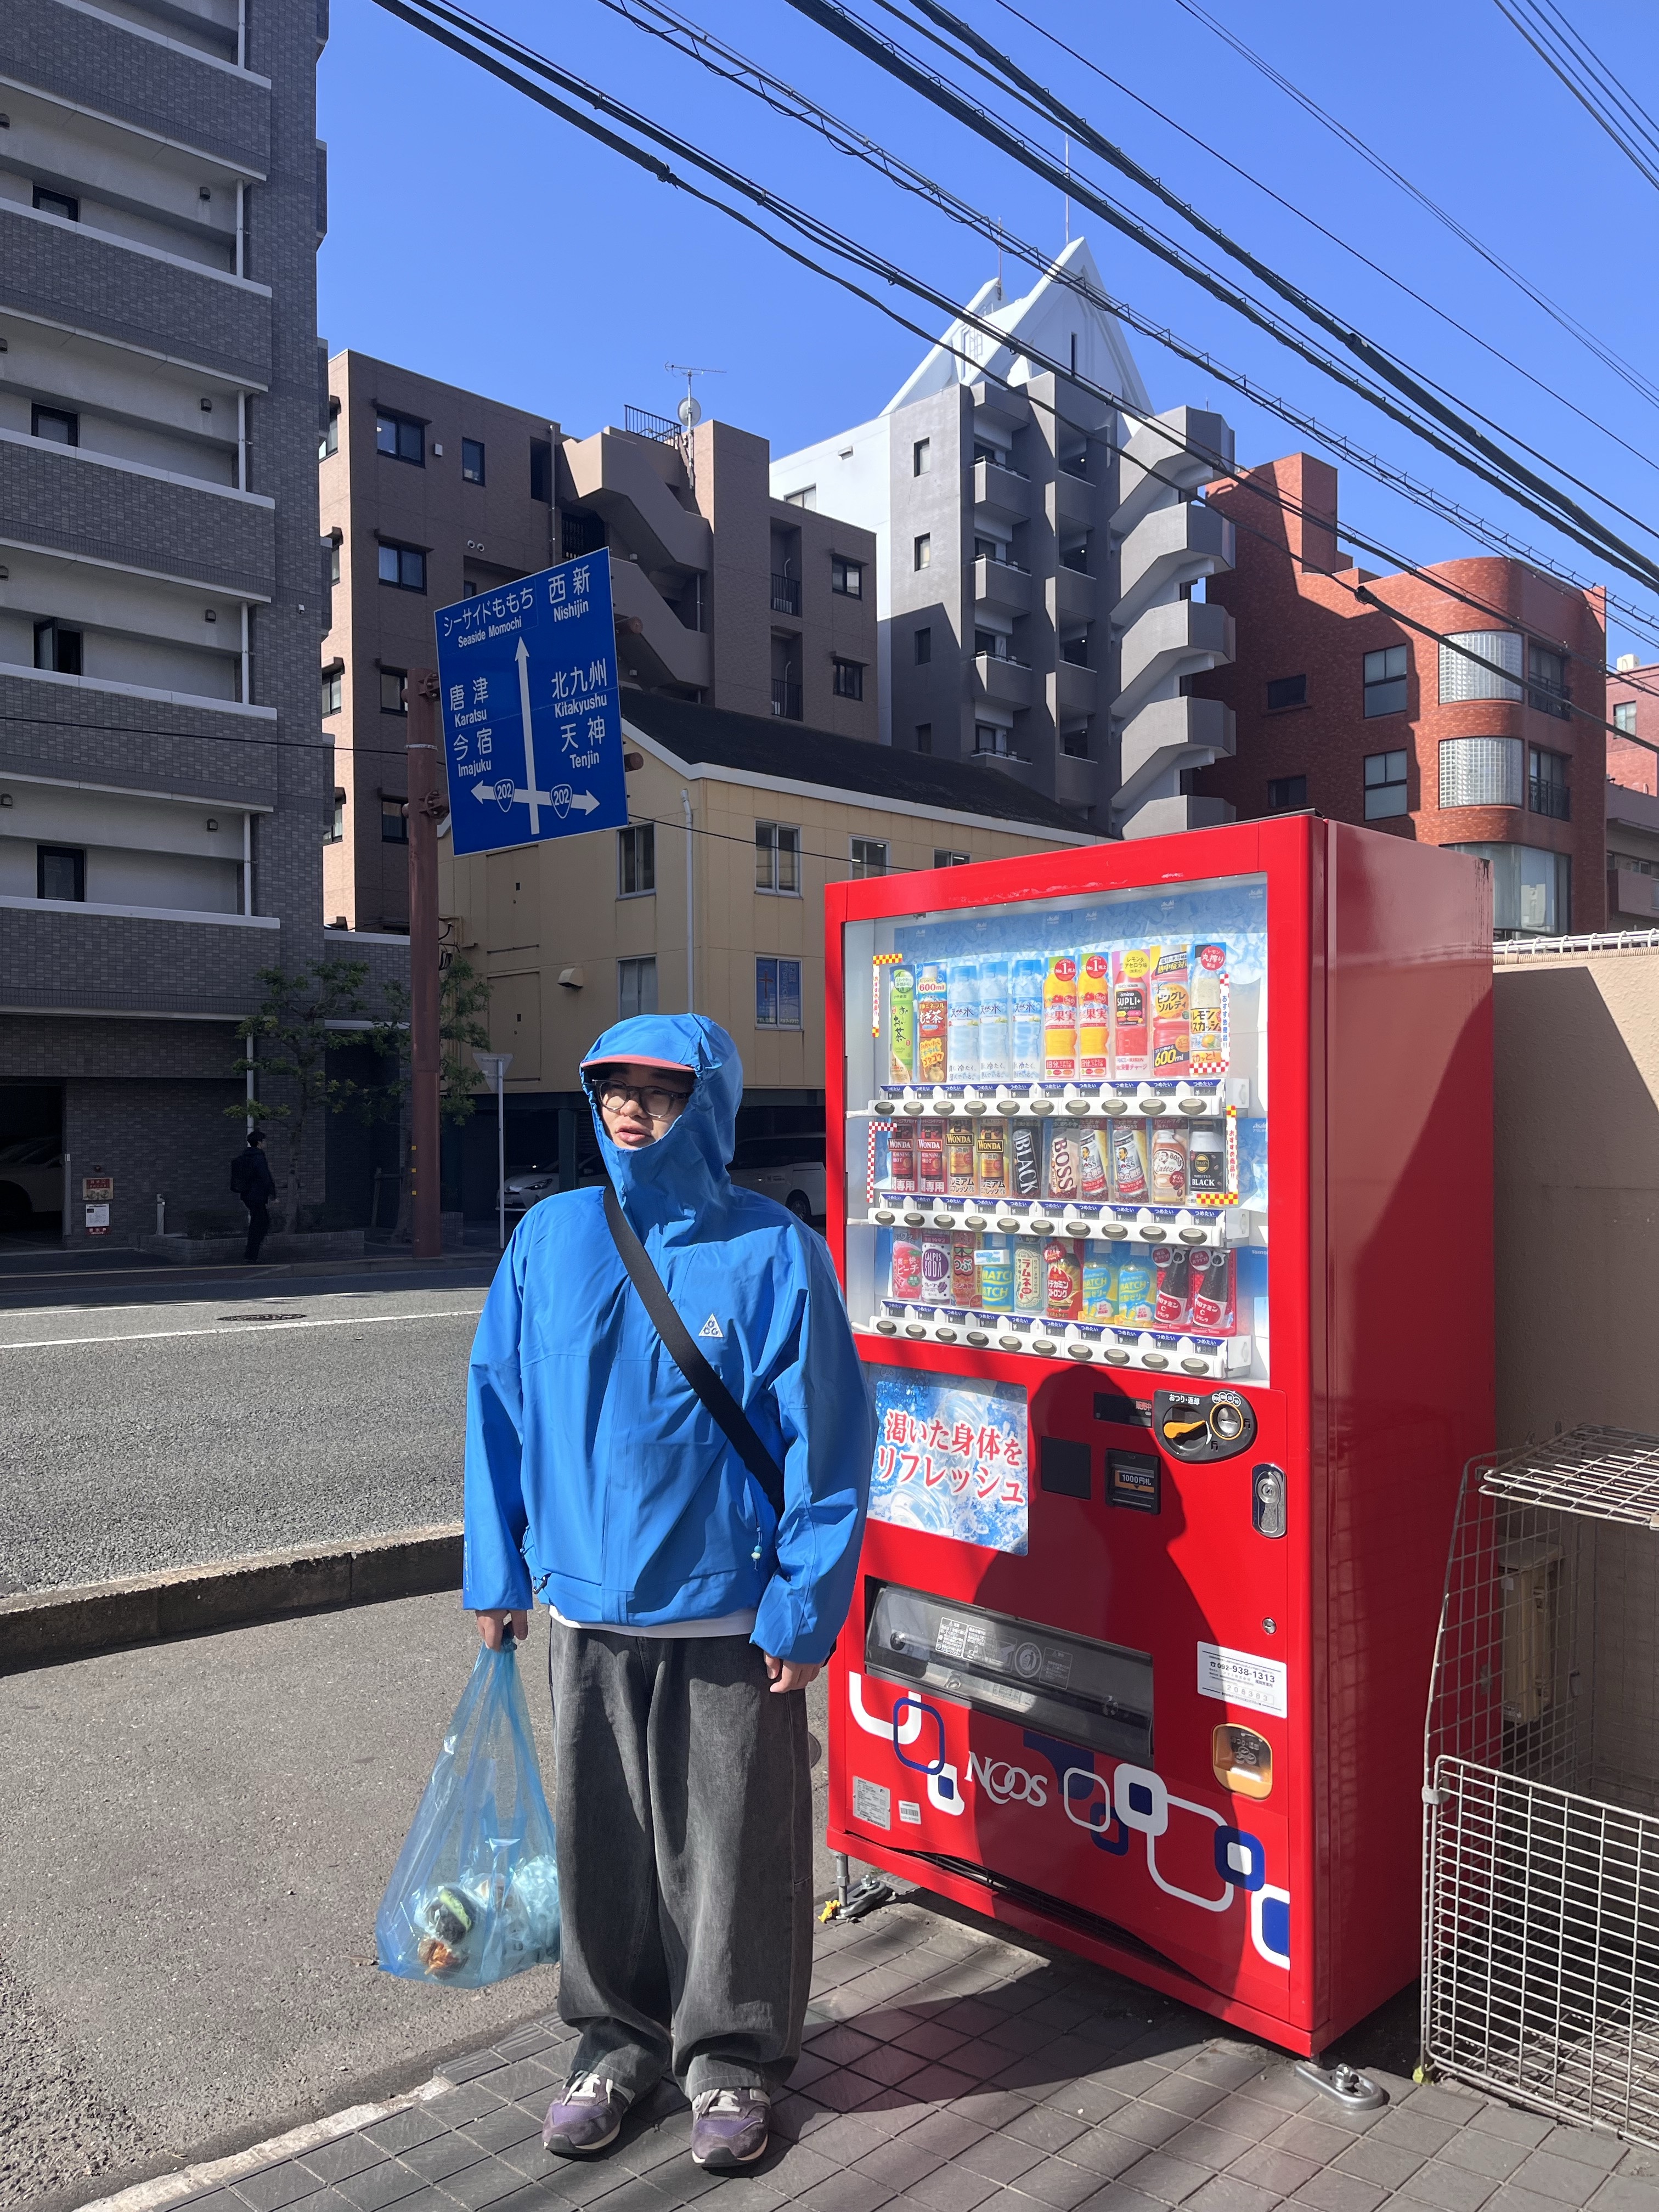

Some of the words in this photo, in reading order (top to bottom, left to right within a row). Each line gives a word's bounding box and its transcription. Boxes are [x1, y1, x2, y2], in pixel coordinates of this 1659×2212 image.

[548, 565, 590, 604] 西新
[444, 587, 533, 637] シーサイドももち
[554, 601, 589, 622] Nishijin
[458, 629, 486, 648] Seaside
[488, 616, 522, 637] Momochi
[551, 658, 607, 699] 北九州
[450, 677, 488, 711] 唐津
[555, 692, 607, 718] Kitakyushu
[454, 710, 487, 728] Karatsu
[560, 715, 605, 752] 天神
[453, 727, 492, 761] 今宿
[458, 758, 492, 777] Imajuku
[569, 751, 600, 769] Tenjin
[497, 783, 512, 799] 202
[554, 789, 569, 806] 202
[1201, 953, 1224, 964] 丸搾り
[919, 983, 944, 991] 600ml
[1117, 997, 1141, 1007] SUPLI+
[1158, 992, 1186, 1003] ピングレ
[951, 1007, 974, 1017] 天然水
[980, 1005, 1001, 1014] 天然水
[1015, 1003, 1035, 1013] 天然水
[1159, 1001, 1187, 1012] ソルティ
[920, 1009, 944, 1024] むぎ茶
[1154, 1049, 1183, 1066] 600ml
[889, 1139, 911, 1148] WONDA
[918, 1139, 940, 1149] WONDA
[946, 1134, 971, 1143] WONDA
[978, 1140, 1001, 1149] WONDA
[1015, 1137, 1039, 1194] BLACK
[1054, 1137, 1074, 1190] BOSS
[1170, 1153, 1182, 1166] BOSS
[925, 1251, 941, 1261] CALPIS
[898, 1265, 919, 1274] ピーチ
[924, 1262, 942, 1278] SODA
[1021, 1259, 1031, 1287] ラムネ
[1169, 1394, 1200, 1406] おつり・返却
[886, 1411, 1023, 1466] 渇いた身体を
[879, 1447, 1024, 1503] リフレッシュ
[1122, 1474, 1151, 1485] 1000円札
[1217, 1663, 1275, 1683] 092-938-1313
[1227, 1685, 1268, 1701] 208383
